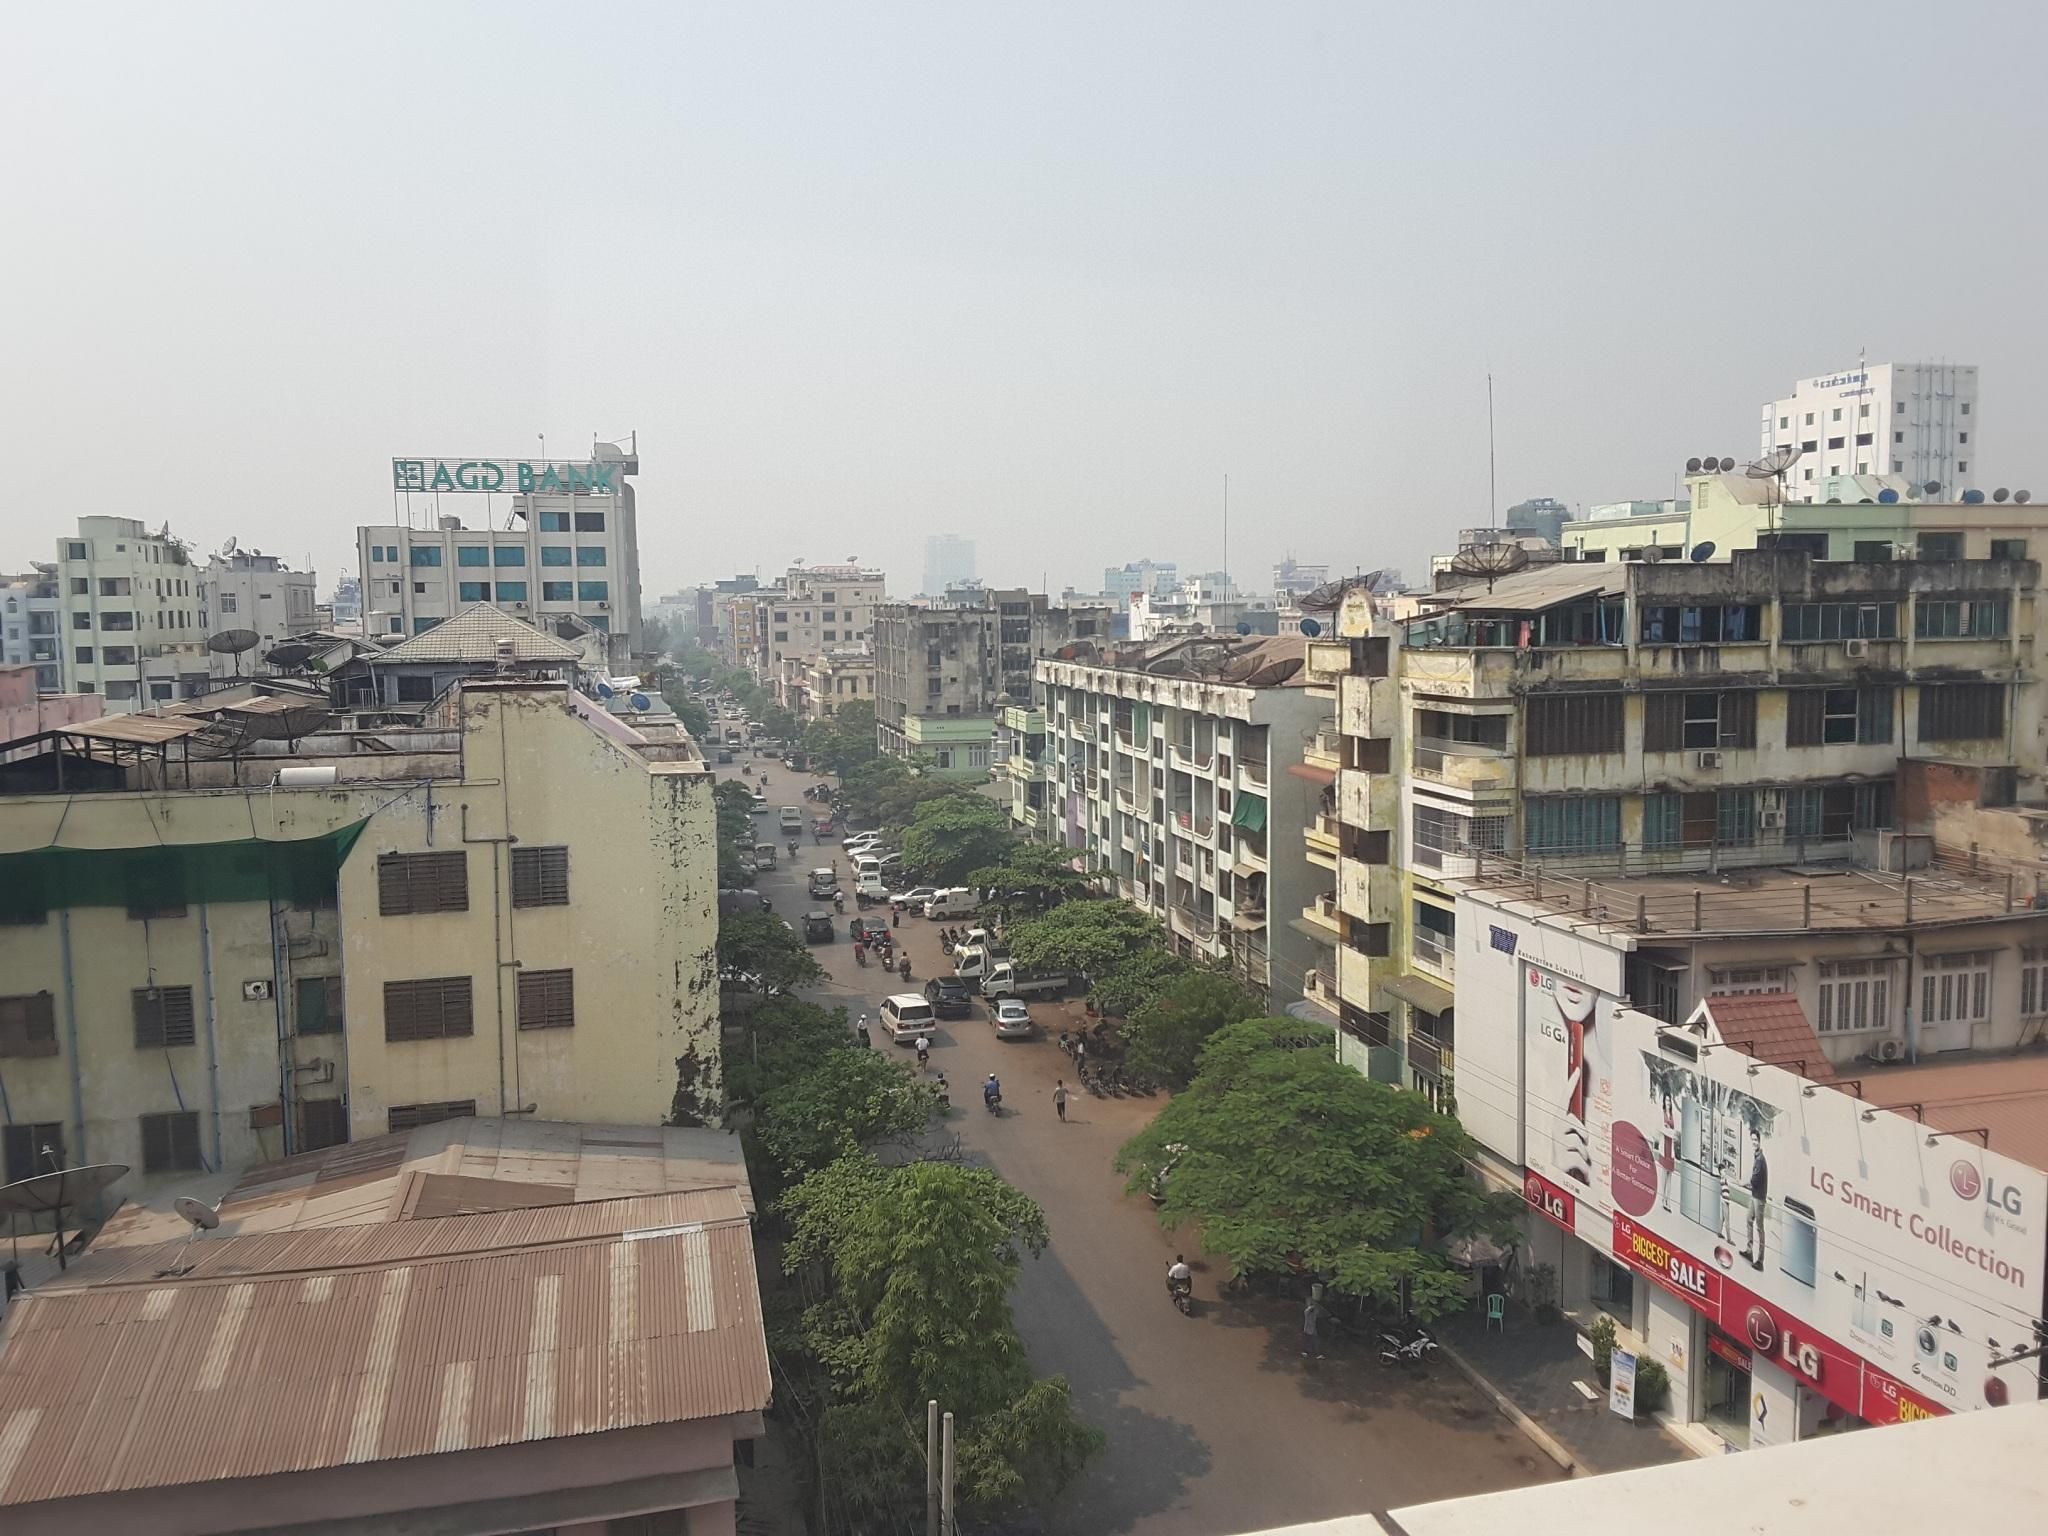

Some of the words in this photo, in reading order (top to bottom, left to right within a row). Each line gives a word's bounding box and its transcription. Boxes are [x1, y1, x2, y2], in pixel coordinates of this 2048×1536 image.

[430, 461, 504, 491] AGD
[517, 462, 619, 495] BANK
[1540, 975, 1553, 991] LG
[1541, 1023, 1552, 1038] LG
[1544, 1190, 1564, 1220] LG
[1986, 1177, 2022, 1216] LG
[1621, 1221, 1632, 1235] LG
[1810, 1166, 1834, 1196] LG
[1841, 1181, 1903, 1229] Smart
[1909, 1214, 2025, 1288] Collection
[1632, 1232, 1671, 1271] BIGGEST
[1669, 1256, 1706, 1296] SALE
[1783, 1330, 1819, 1381] LG
[1881, 1380, 1898, 1399] LG
